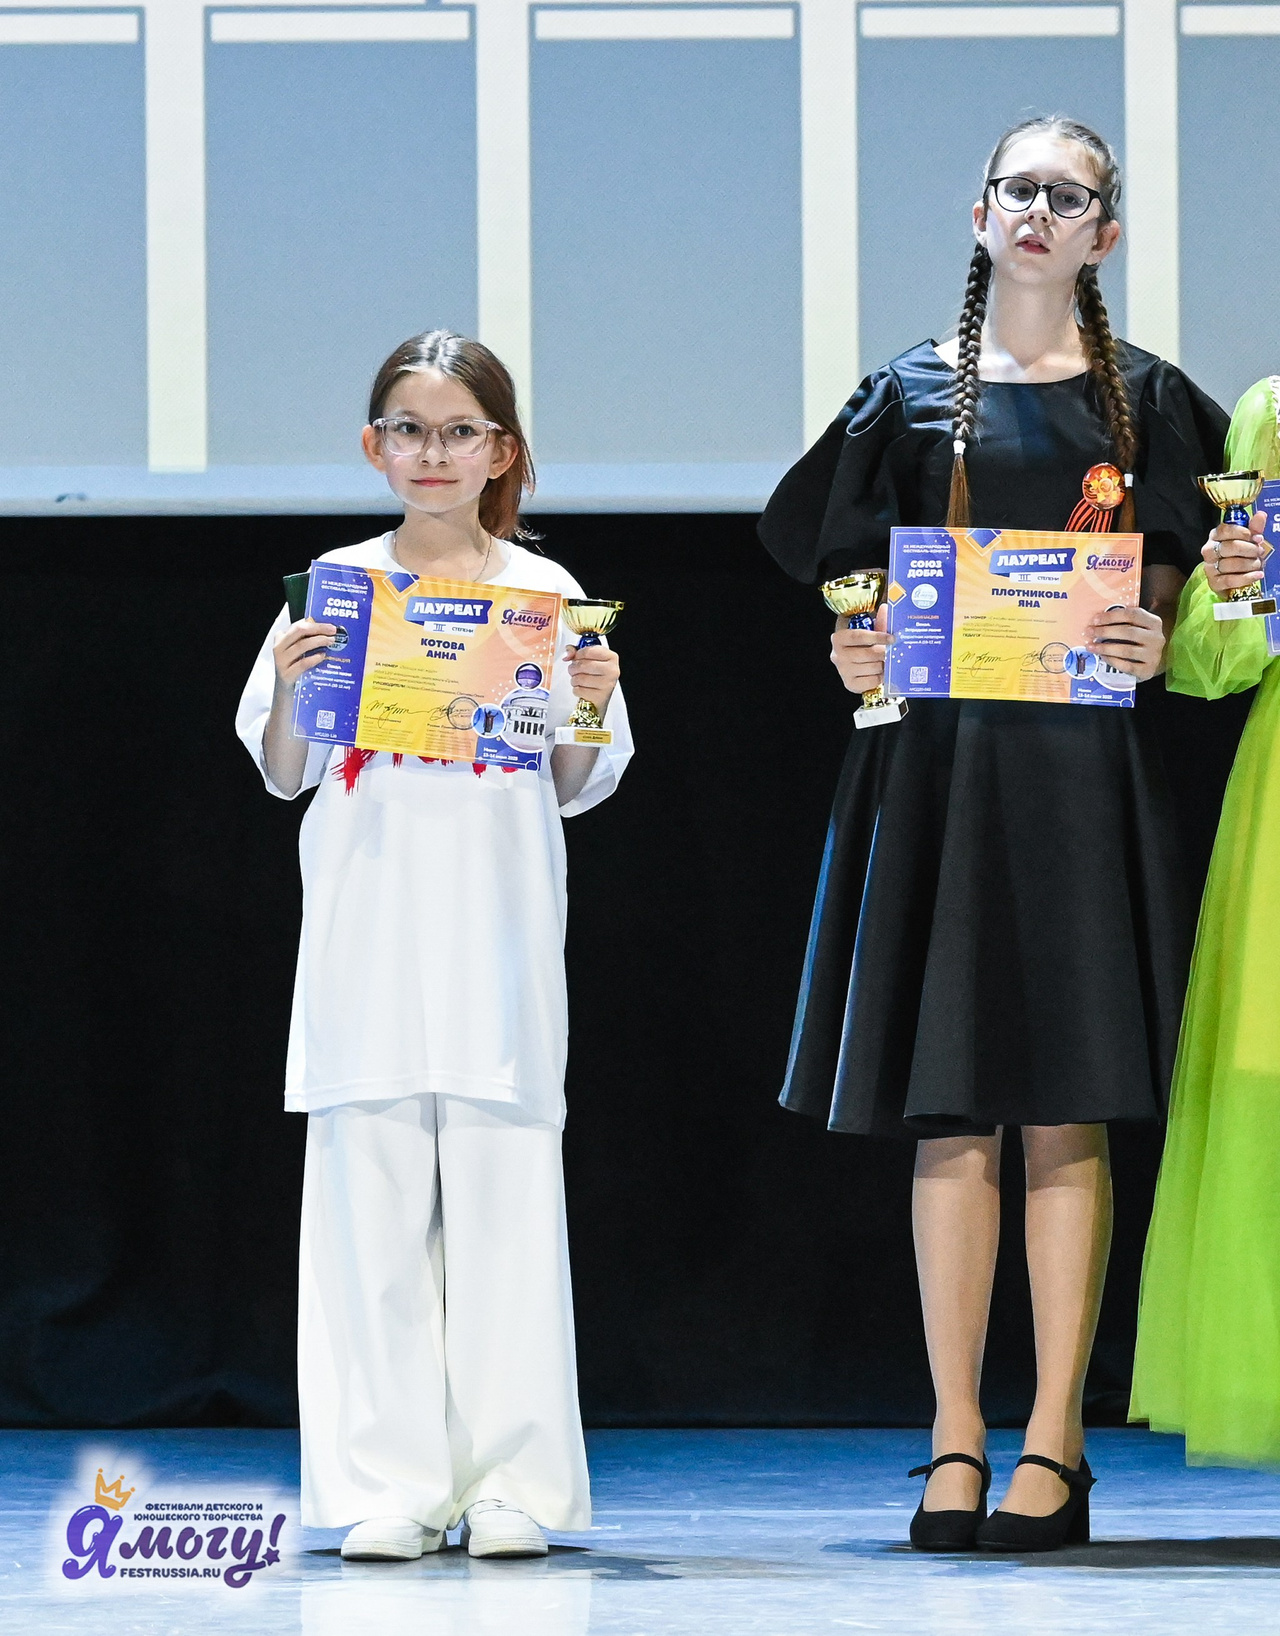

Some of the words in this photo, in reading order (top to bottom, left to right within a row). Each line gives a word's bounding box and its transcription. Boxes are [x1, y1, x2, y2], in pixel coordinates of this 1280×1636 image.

[910, 560, 942, 568] СОЮЗ
[997, 553, 1068, 567] ЛАУРЕАТ
[907, 569, 944, 578] ДОБРА
[991, 588, 1068, 600] ПЛОТНИКОВА
[327, 598, 358, 609] СОЮЗ
[413, 602, 483, 616] ЛАУРЕАТ
[1018, 600, 1041, 608] ЯНА
[323, 607, 359, 619] ДОБРА
[421, 638, 465, 651] КОТОВА
[426, 650, 457, 661] АННА
